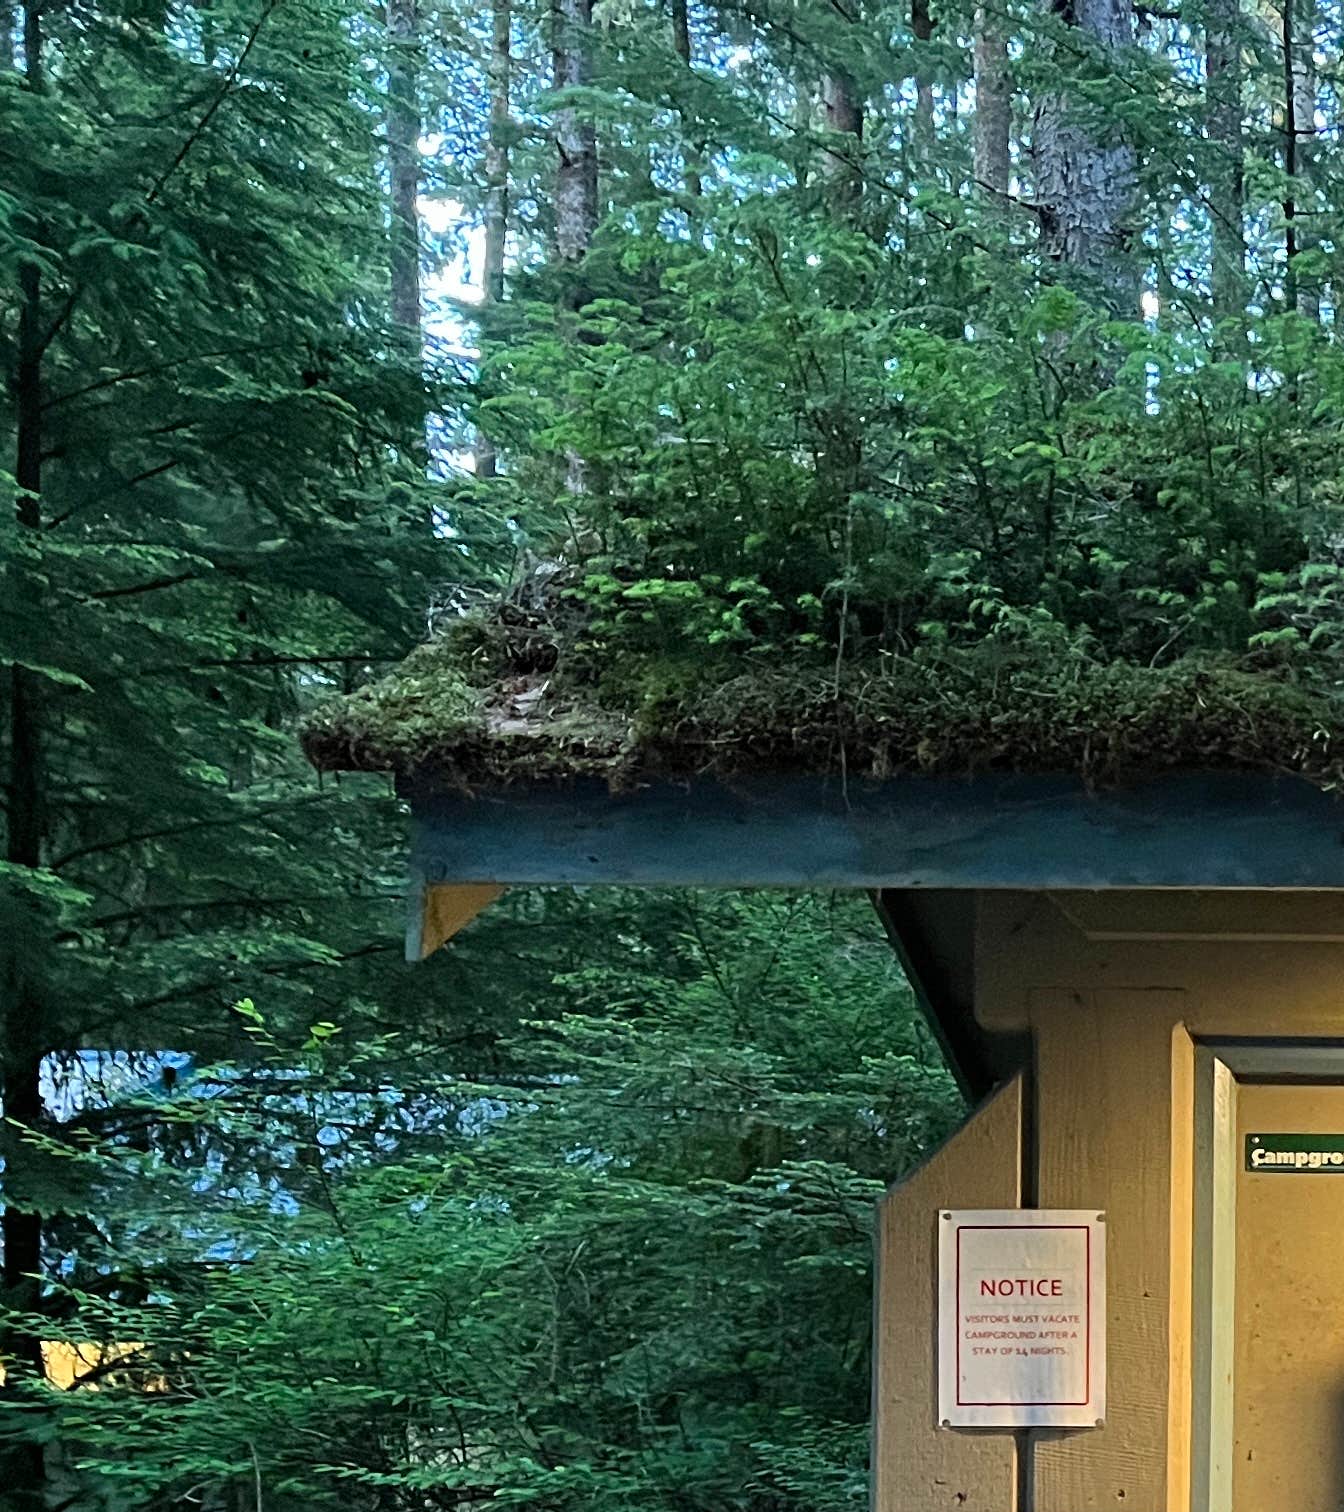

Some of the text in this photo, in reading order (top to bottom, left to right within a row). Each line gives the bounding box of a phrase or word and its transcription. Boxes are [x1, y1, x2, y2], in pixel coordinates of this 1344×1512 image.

[980, 1279, 1063, 1297] NOTICE
[965, 1314, 1080, 1324] VISITORS MUST VACATE
[965, 1330, 1078, 1340] CAMPGROUND AFTER A
[972, 1347, 998, 1356] STAY
[1000, 1347, 1013, 1356] OF
